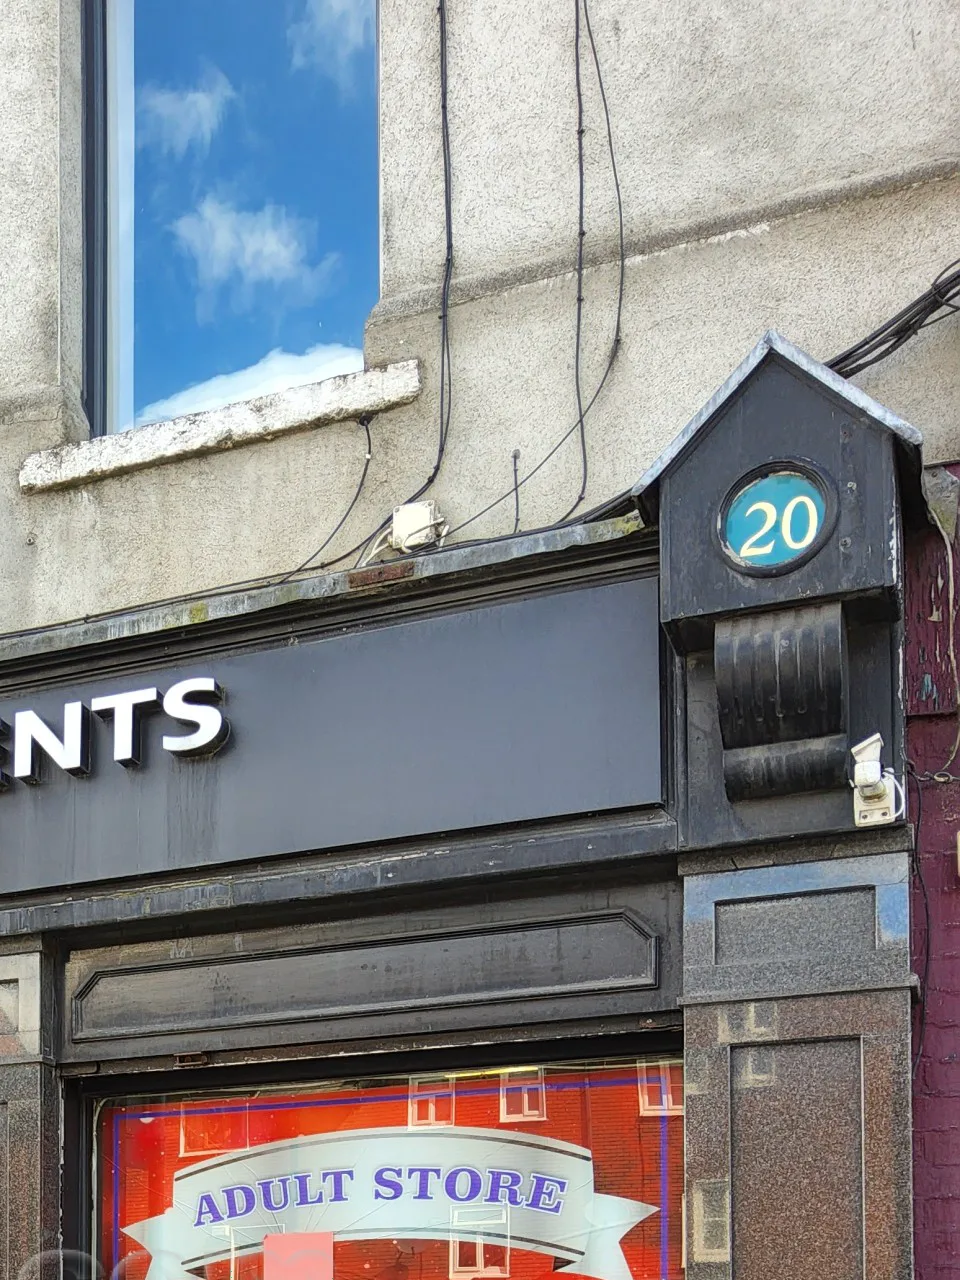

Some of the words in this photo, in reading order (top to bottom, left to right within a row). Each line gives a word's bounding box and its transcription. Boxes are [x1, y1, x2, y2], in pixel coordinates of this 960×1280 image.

[739, 495, 819, 558] 20
[192, 1168, 354, 1228] ADULT
[373, 1166, 570, 1215] STORE
